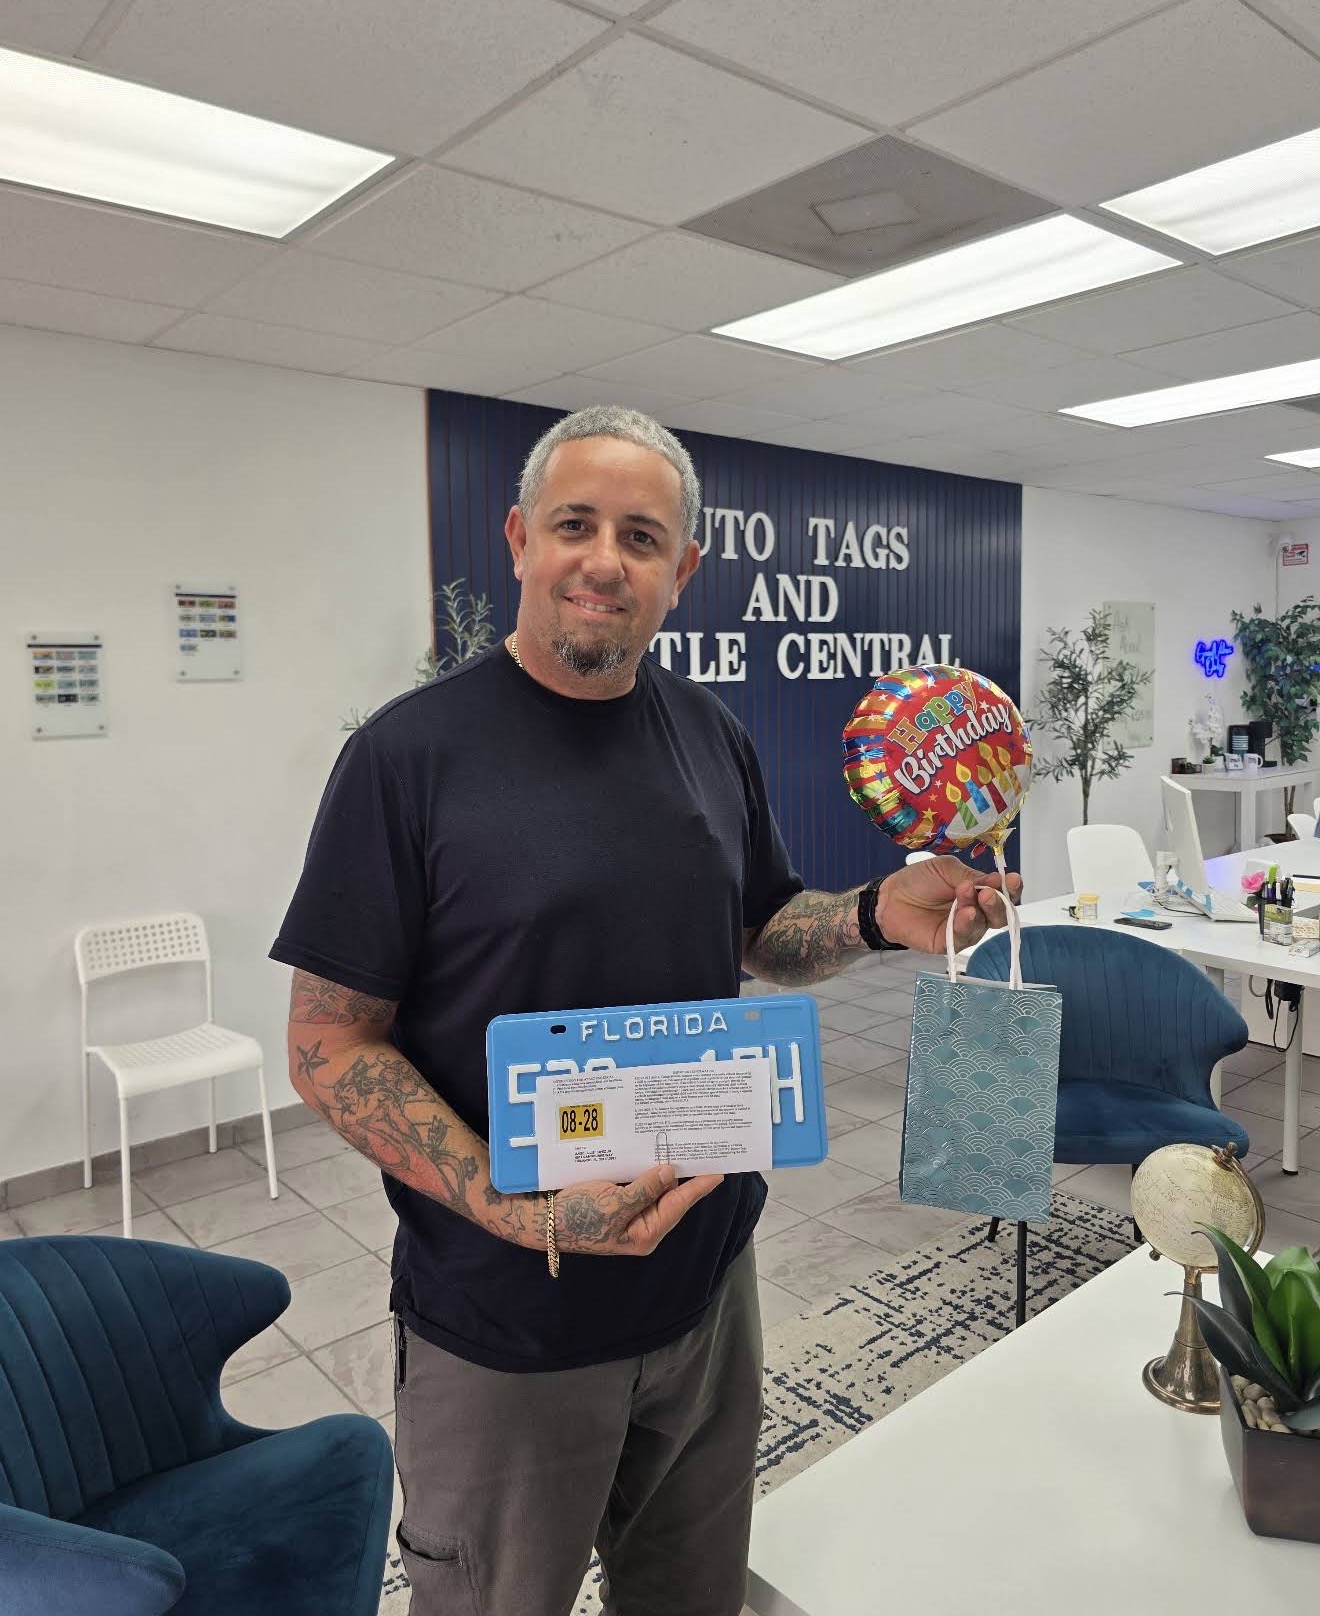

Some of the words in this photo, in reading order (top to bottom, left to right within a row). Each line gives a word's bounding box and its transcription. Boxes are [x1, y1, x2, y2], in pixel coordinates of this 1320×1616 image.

[699, 507, 775, 561] TO
[808, 517, 910, 571] TAGS
[742, 573, 839, 623] AND
[649, 632, 746, 682] TLE
[777, 632, 960, 680] CENTRAL
[888, 682, 977, 754] Happy
[893, 702, 1012, 795] Birthday
[580, 1010, 729, 1042] FLORIDA
[561, 1108, 599, 1134] 08-28
